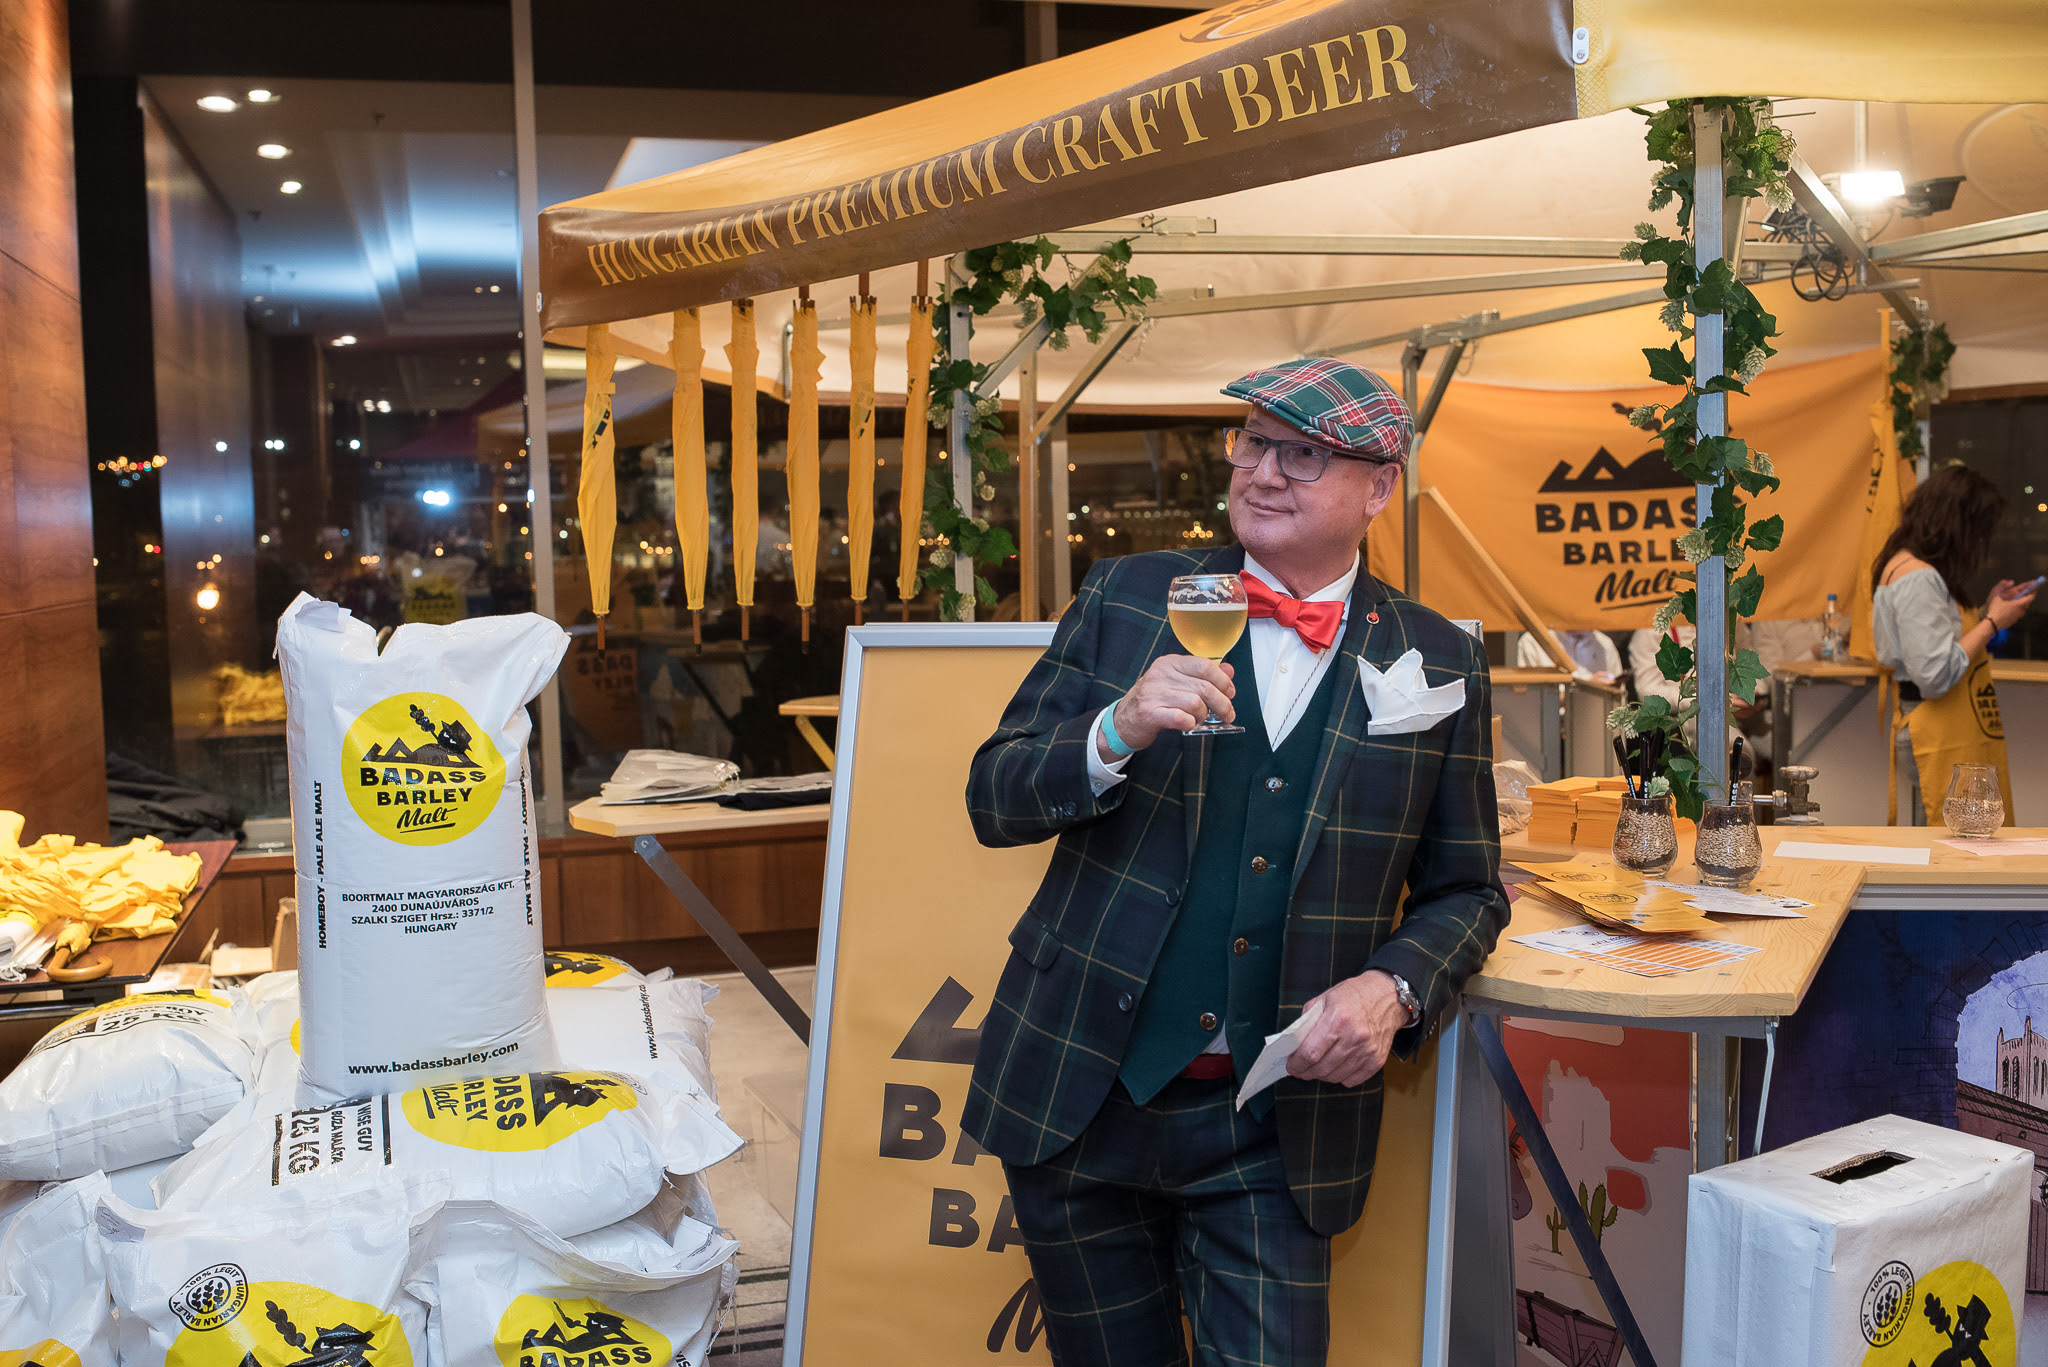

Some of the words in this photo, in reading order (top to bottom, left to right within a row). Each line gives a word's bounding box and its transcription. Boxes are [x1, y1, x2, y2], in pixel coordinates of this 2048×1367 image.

[587, 203, 784, 287] HUNGARIAN
[786, 139, 1007, 245] PREMIUM
[1012, 76, 1208, 184] CRAFT
[1217, 24, 1418, 134] BEER
[1535, 495, 1743, 533] BADAS
[1563, 540, 1685, 565] BARLE
[360, 767, 487, 786] BADASS
[314, 780, 323, 815] MALT
[377, 788, 473, 806] BARLEY
[315, 818, 324, 842] ALE
[396, 806, 458, 829] Malt
[316, 845, 325, 875] PALE
[523, 836, 531, 866] PALE
[341, 892, 404, 902] BOORTMALT
[407, 883, 496, 900] MAGYARORSZÁG
[498, 880, 515, 891] KFT.
[317, 885, 327, 949] HOMEBOY
[351, 915, 388, 925] SZALKI
[391, 913, 427, 923] SZIGET
[462, 906, 494, 918] 3371/2
[372, 904, 398, 913] 2400
[400, 897, 479, 912] DUNAÚJVÁROS
[525, 893, 533, 926] MALT
[404, 922, 458, 934] HUNGARY
[638, 984, 658, 1059] www.badassbarley.co
[348, 1042, 519, 1074] www.badassbarley.com
[463, 1080, 489, 1122] RLEY
[492, 1075, 527, 1131] DASS
[290, 1117, 320, 1138] 25
[357, 1104, 372, 1127] WISE
[357, 1127, 373, 1151] GUY
[288, 1141, 320, 1174] KG
[214, 1266, 240, 1278] LEGIT
[1870, 1269, 1890, 1293] 100%
[1891, 1266, 1910, 1282] LEGIT
[172, 1301, 202, 1326] BARLEY
[203, 1279, 245, 1326] HUNGARIAN
[1883, 1281, 1912, 1341] HUNGARIAN
[1863, 1313, 1882, 1342] BARLEY
[520, 1346, 652, 1367] BADASS
